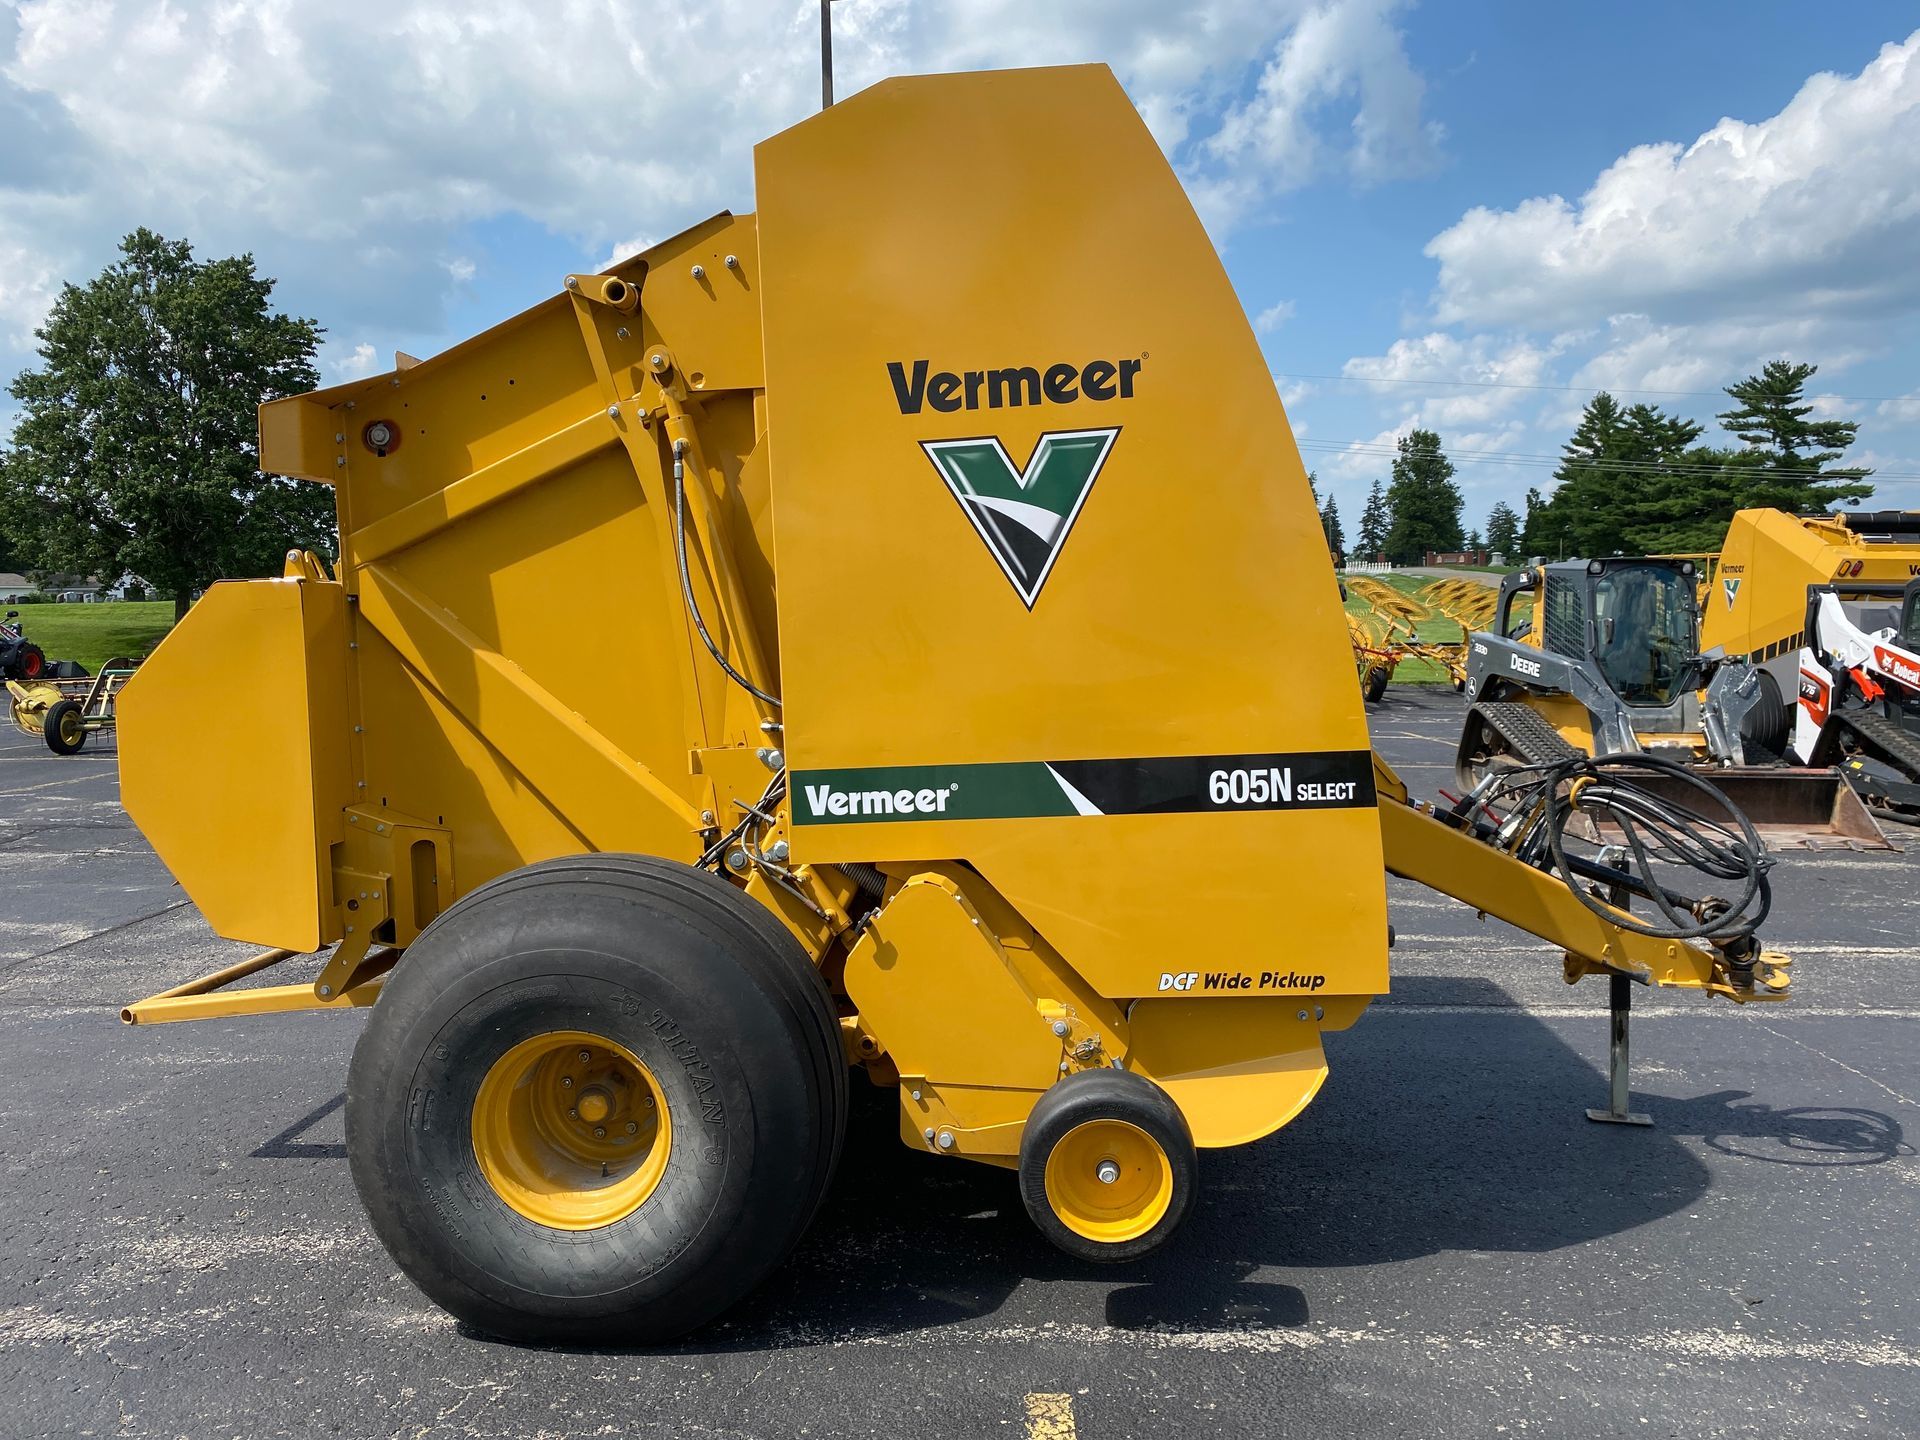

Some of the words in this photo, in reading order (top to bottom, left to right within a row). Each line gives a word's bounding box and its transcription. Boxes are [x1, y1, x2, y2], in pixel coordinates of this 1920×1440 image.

[1474, 642, 1488, 655] 333D
[1510, 652, 1541, 678] DEERE
[1209, 767, 1292, 804] 605N
[1297, 782, 1356, 801] SELECT
[1158, 972, 1199, 991] DCF
[1204, 973, 1252, 990] Wide
[1259, 971, 1325, 991] Pickup
[645, 1008, 727, 1129] TITAN
